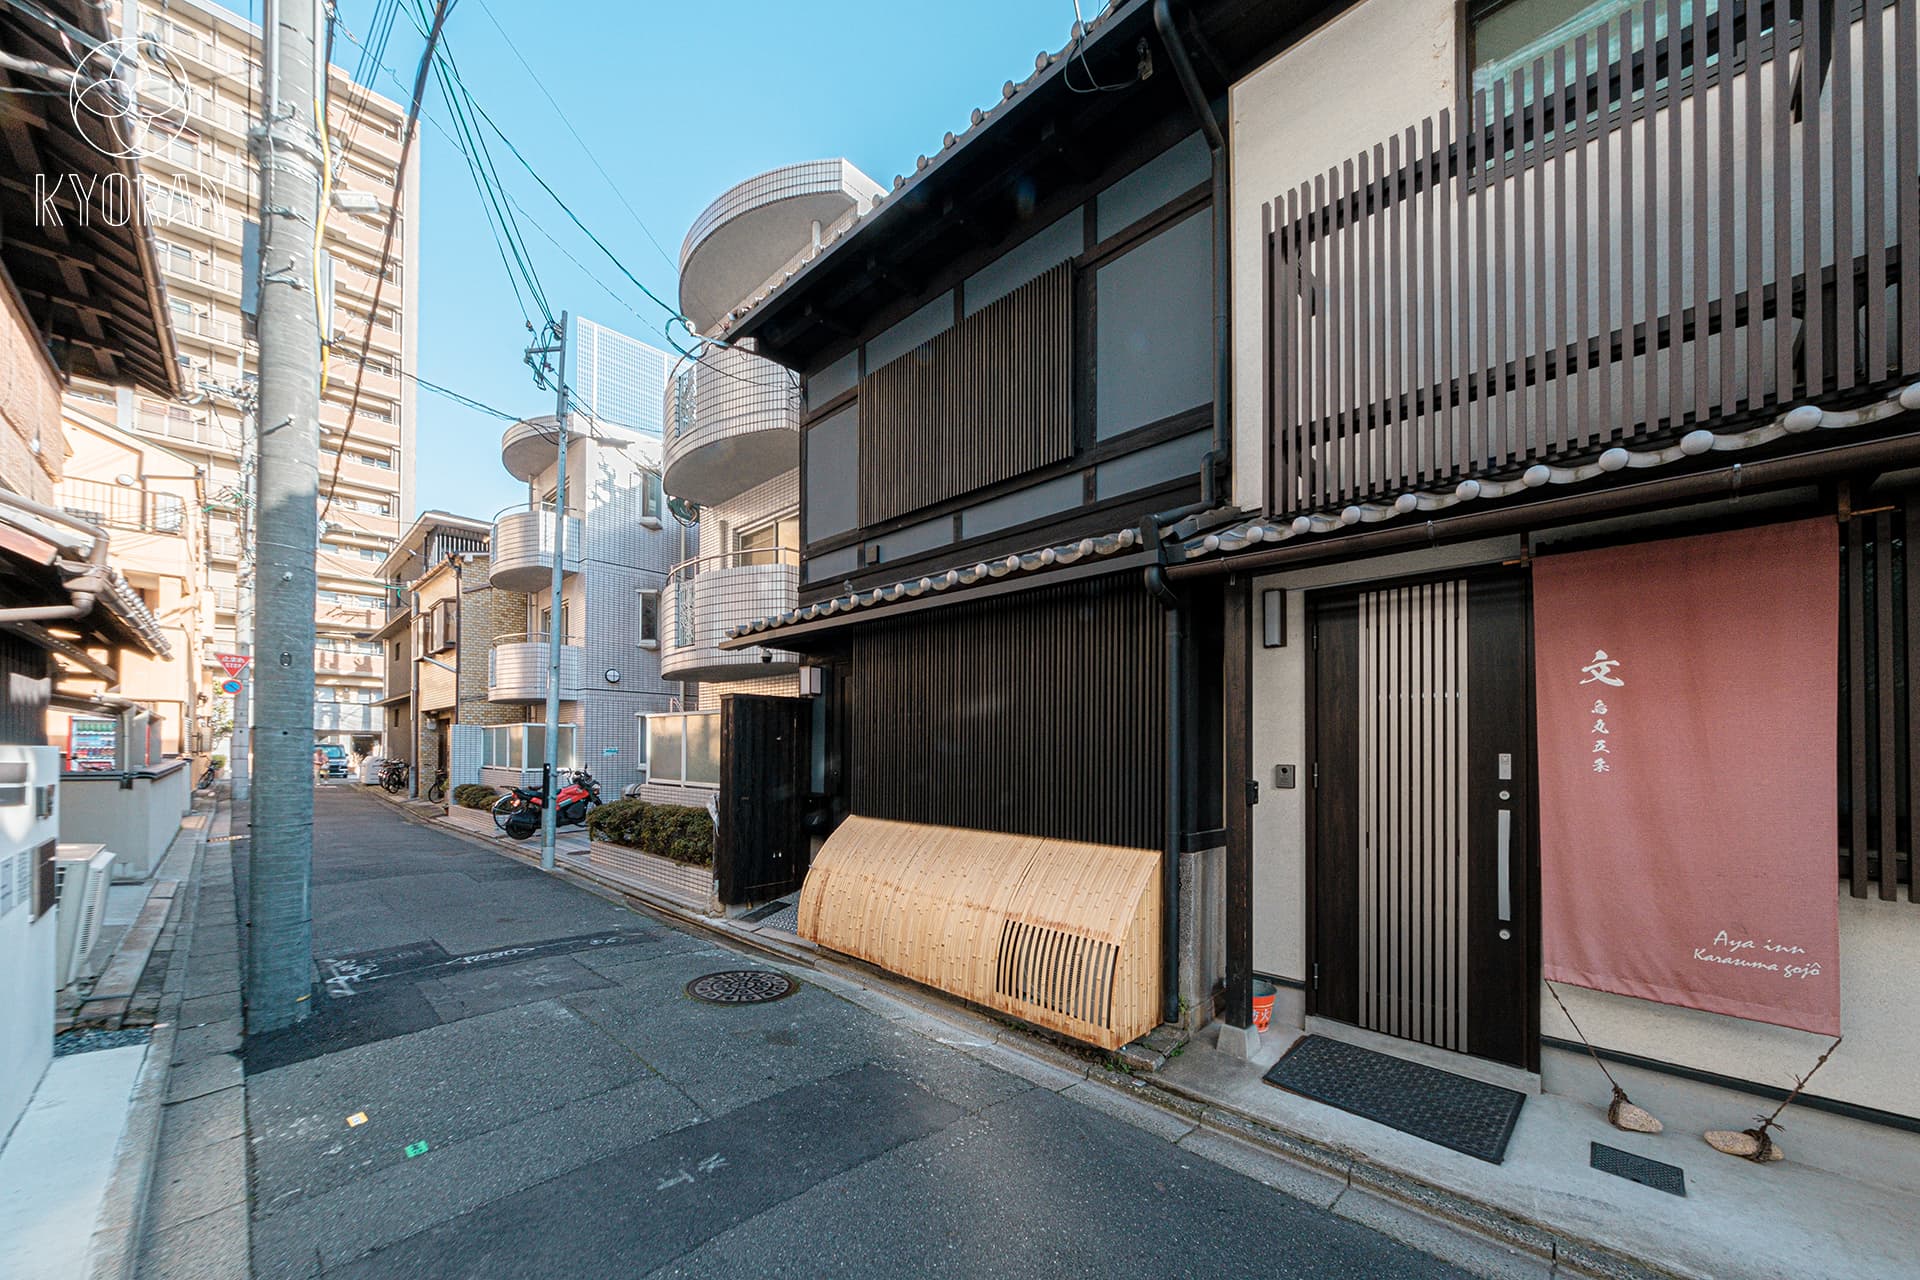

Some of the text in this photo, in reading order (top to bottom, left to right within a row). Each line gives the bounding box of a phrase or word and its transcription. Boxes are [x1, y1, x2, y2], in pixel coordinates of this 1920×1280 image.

[1579, 649, 1625, 687] 文
[1713, 930, 1805, 954] Aya inn
[1693, 948, 1779, 971] Karasuma
